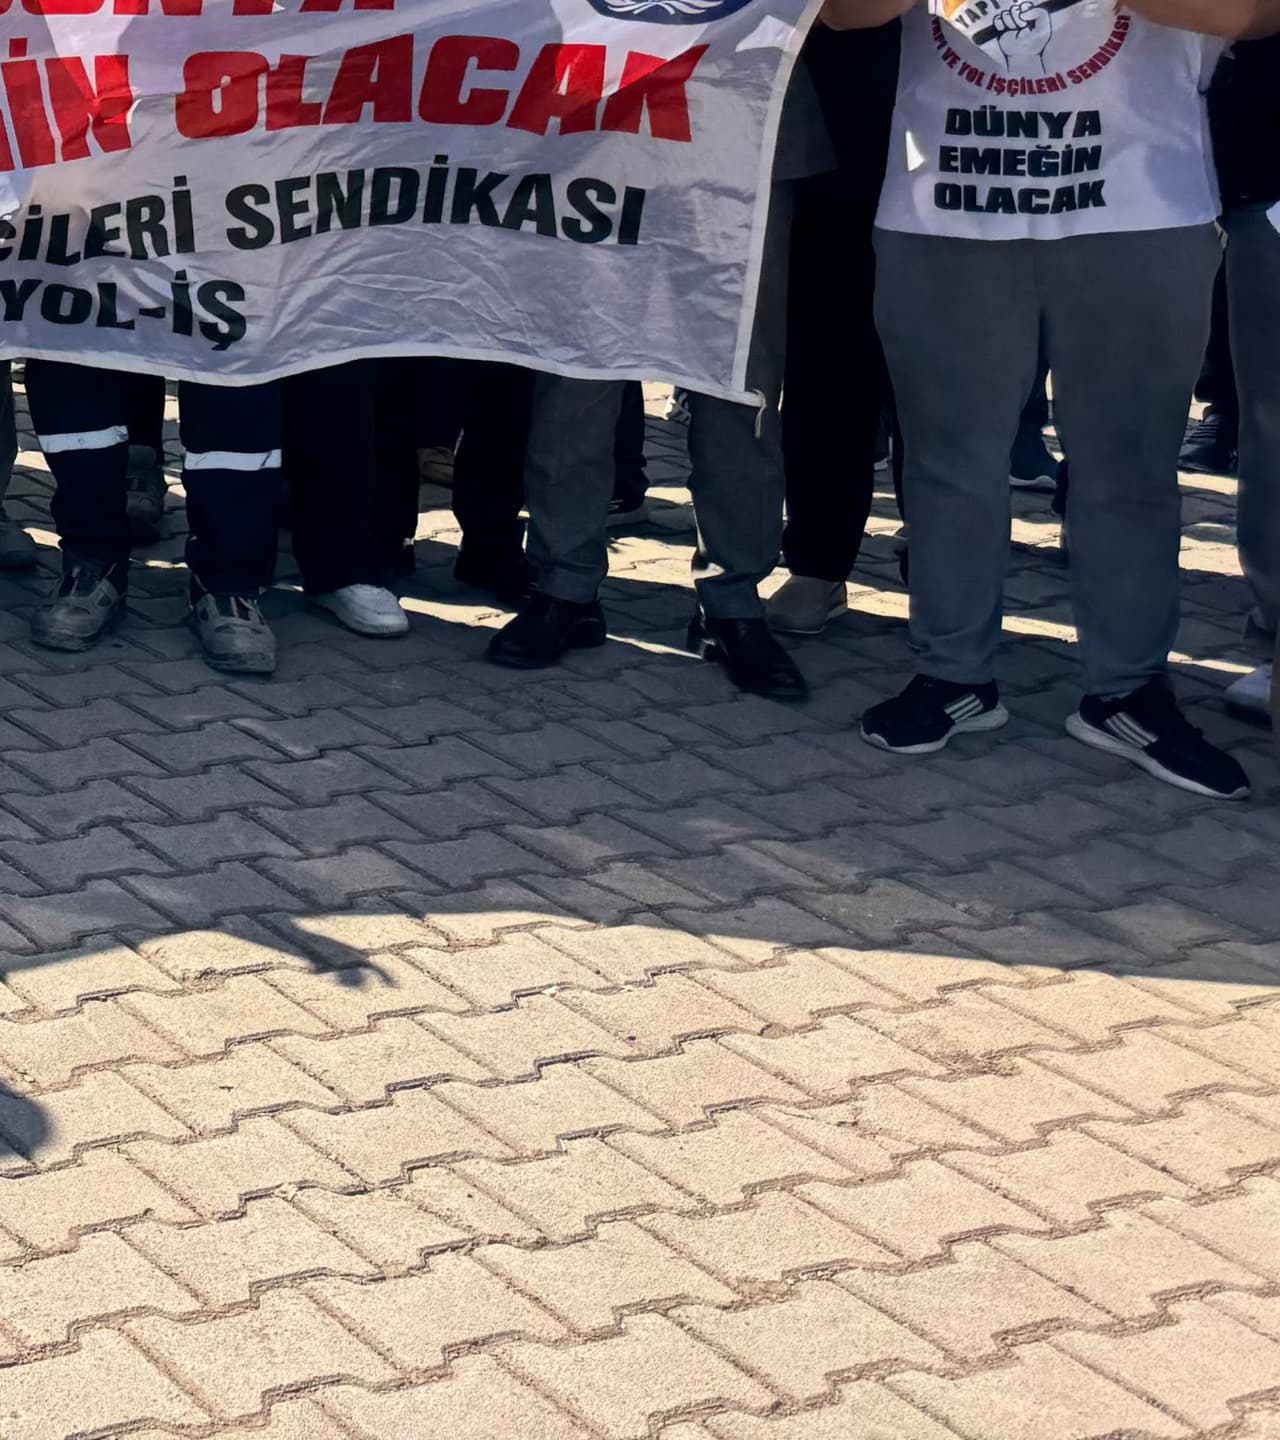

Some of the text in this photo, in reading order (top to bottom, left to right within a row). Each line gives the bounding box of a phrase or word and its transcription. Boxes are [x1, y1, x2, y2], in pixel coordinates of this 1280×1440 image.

[942, 44, 961, 68] VE
[957, 61, 985, 87] YOL
[986, 73, 1068, 98] İŞÇİLERİ
[1066, 14, 1132, 85] SENDİKASI
[175, 33, 710, 143] OLACAK
[944, 104, 1102, 139] DÜNYA
[939, 144, 1103, 178] EMEĞİN
[224, 154, 647, 251] SENDİKASI
[934, 179, 1107, 215] OLACAK
